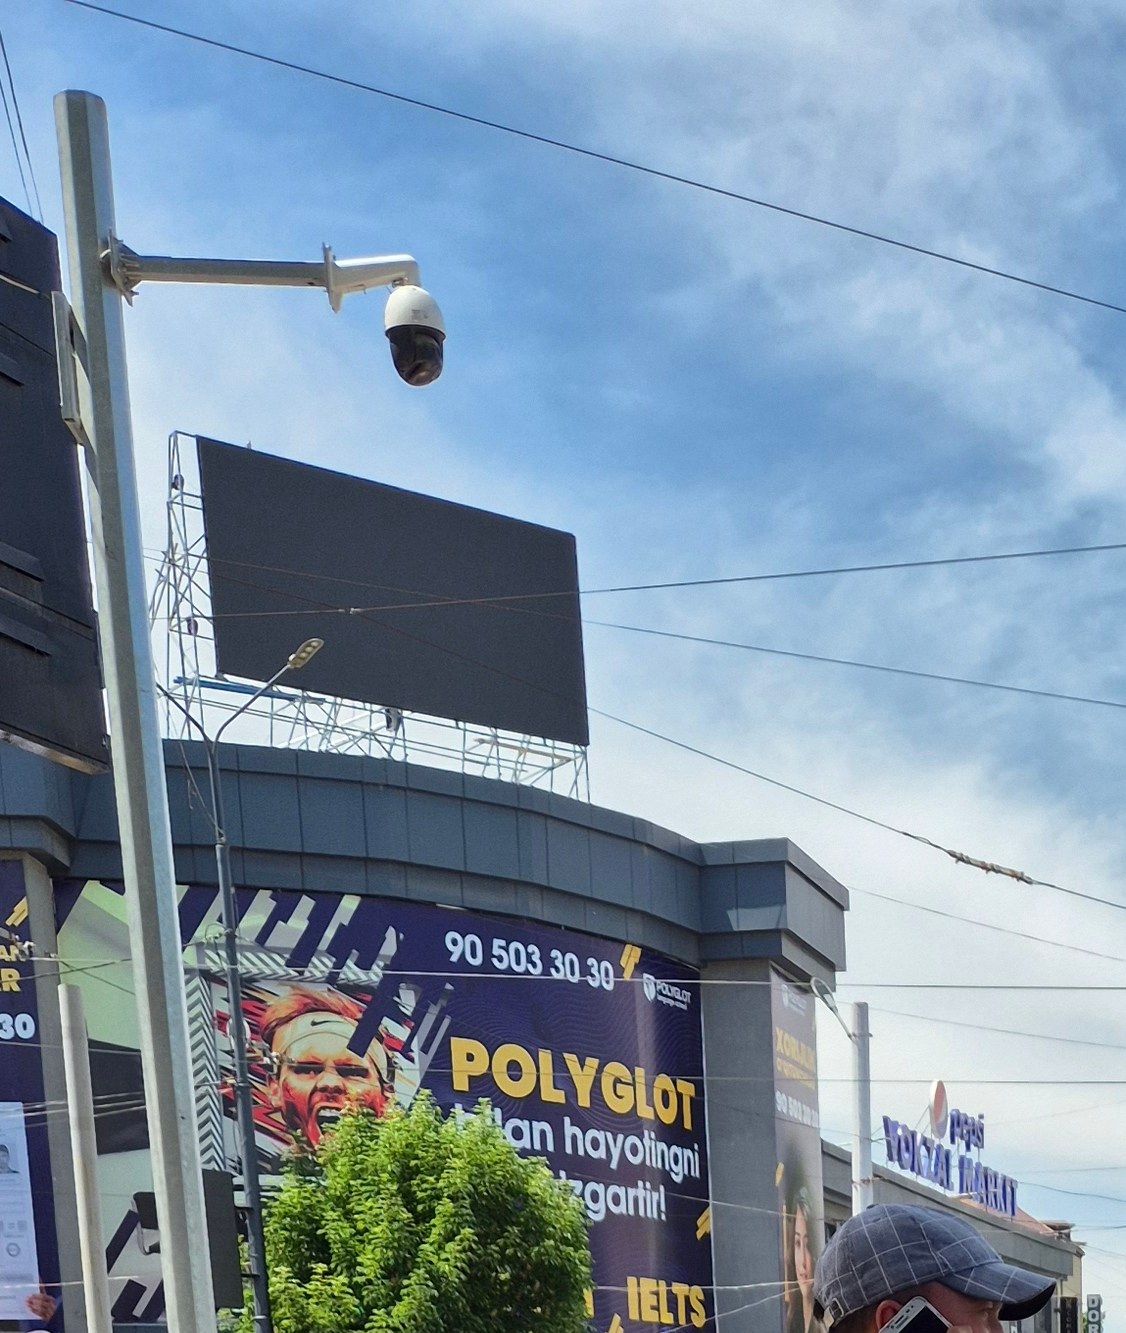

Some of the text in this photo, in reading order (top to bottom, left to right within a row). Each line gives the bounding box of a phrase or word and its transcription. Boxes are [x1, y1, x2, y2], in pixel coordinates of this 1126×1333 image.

[445, 931, 614, 991] 90 503 30 30
[450, 1036, 696, 1130] POLYGLOT
[563, 1117, 700, 1184] hayotingni
[949, 1109, 984, 1152] pepsi
[626, 1276, 706, 1328] IELTS
